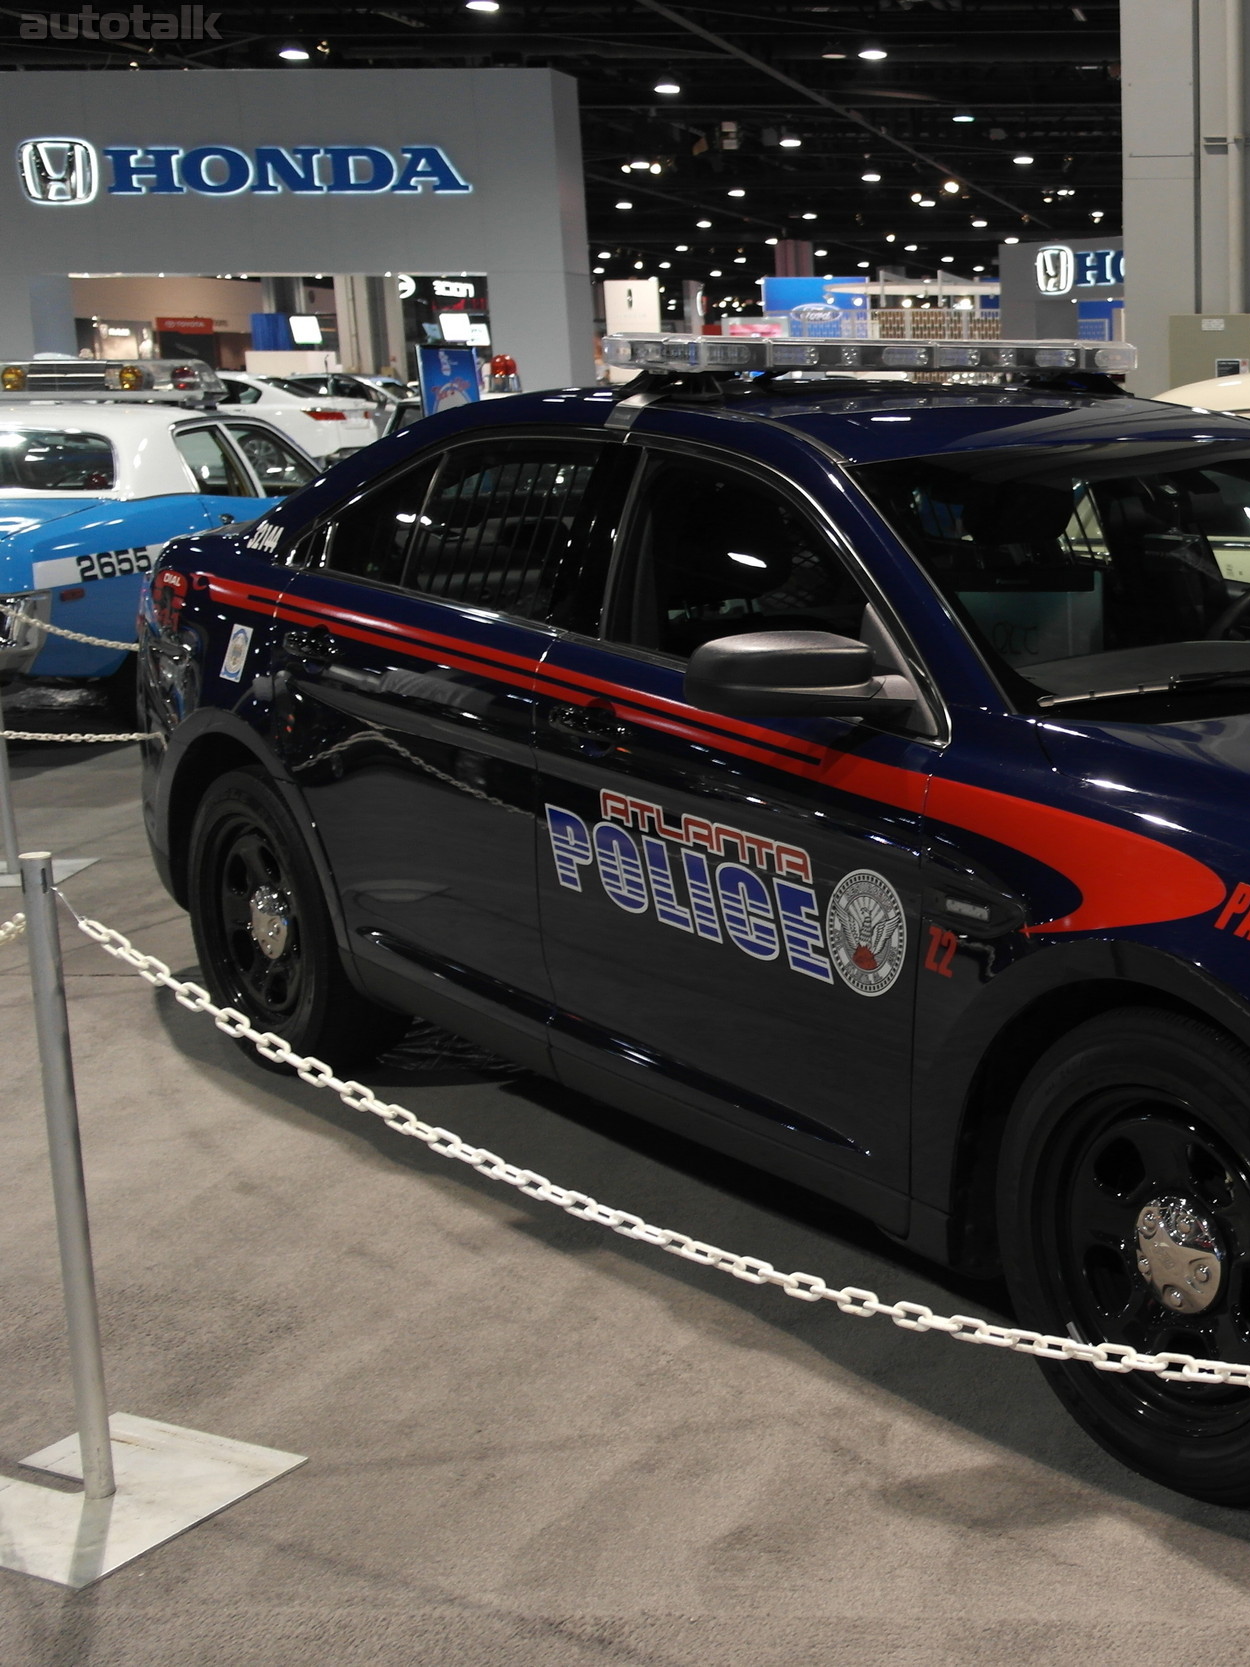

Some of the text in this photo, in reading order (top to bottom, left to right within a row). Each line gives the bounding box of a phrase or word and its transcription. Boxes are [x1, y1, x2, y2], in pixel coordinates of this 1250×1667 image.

[104, 146, 473, 195] HONDA
[76, 546, 151, 582] 2655
[163, 573, 182, 588] DIAL
[600, 788, 813, 885] ATLANTA
[545, 803, 834, 985] POLICE
